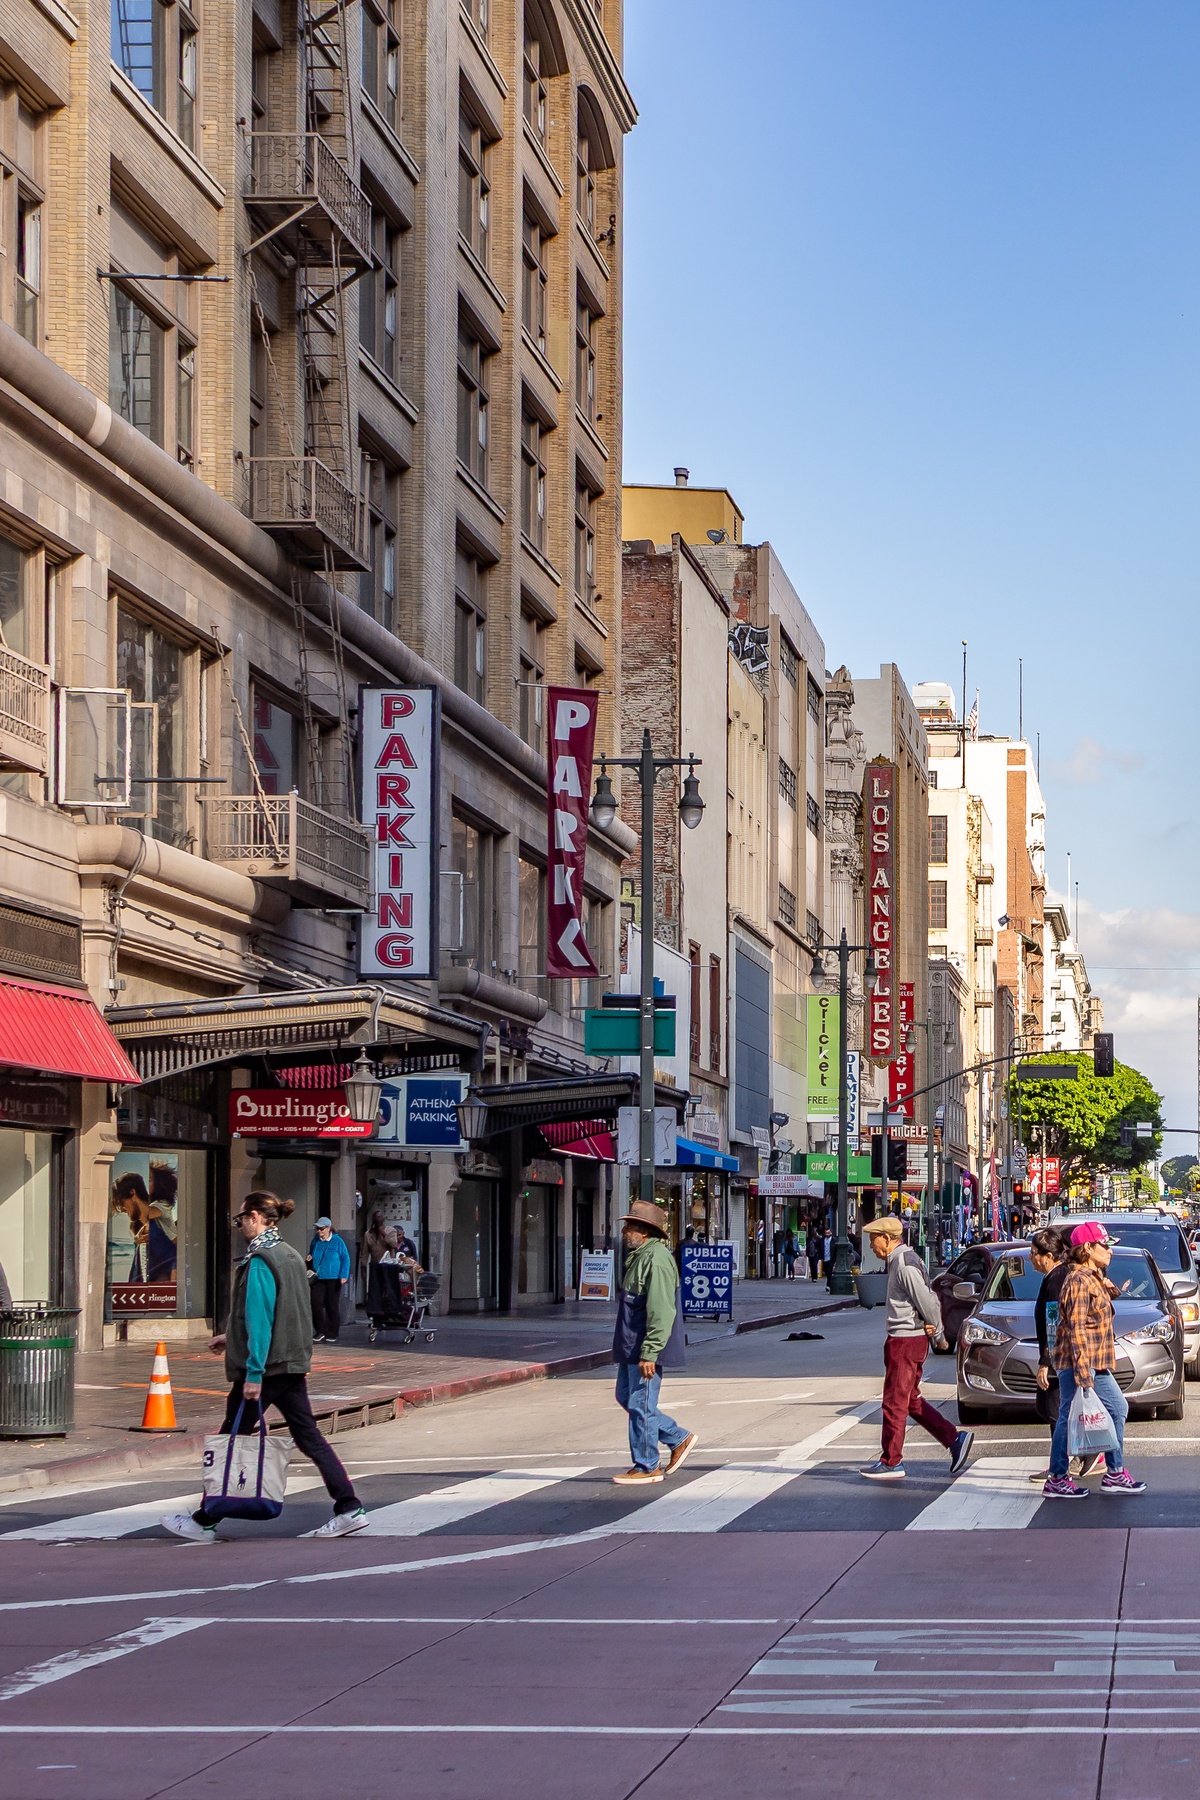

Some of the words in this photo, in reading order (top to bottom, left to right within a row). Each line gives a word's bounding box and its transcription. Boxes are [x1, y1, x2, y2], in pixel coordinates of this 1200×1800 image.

[552, 699, 591, 906] PARK
[872, 777, 890, 853] LOS
[374, 693, 418, 969] PARKING
[871, 867, 891, 1051] ANGELES
[818, 996, 830, 1087] cricket
[236, 1094, 350, 1124] Burlingto
[410, 1098, 456, 1108] ATHENA
[409, 1112, 457, 1123] PARKING
[891, 1125, 929, 1138] ANGELE
[810, 1162, 834, 1171] cricket
[1030, 1159, 1059, 1171] dogs!
[684, 1247, 730, 1258] PUBLIC
[691, 1261, 728, 1270] PARKING
[684, 1300, 705, 1308] FLAT
[706, 1300, 729, 1309] RATE
